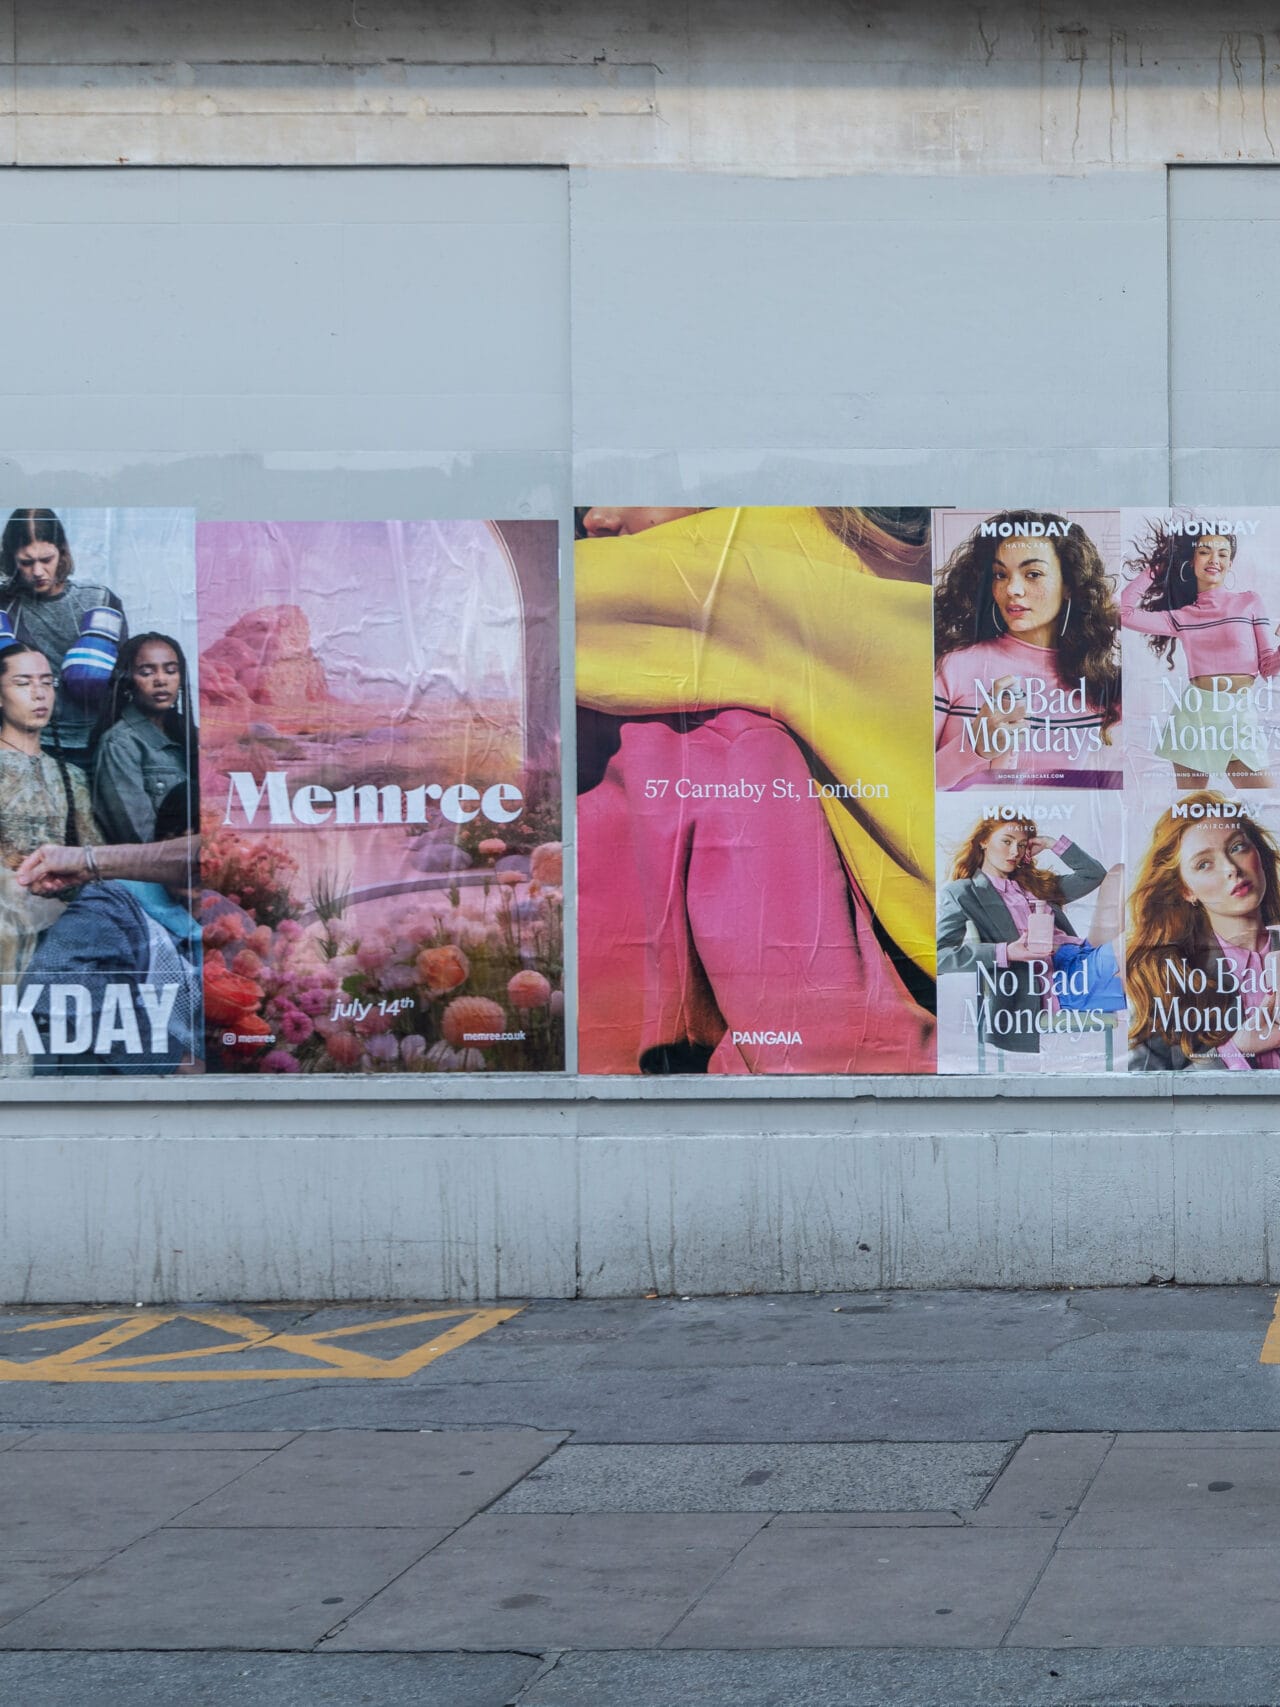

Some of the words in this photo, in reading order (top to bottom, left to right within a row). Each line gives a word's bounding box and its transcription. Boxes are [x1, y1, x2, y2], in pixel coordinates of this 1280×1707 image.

[980, 521, 1073, 537] MONDAY
[1167, 519, 1260, 536] MONDAY
[974, 677, 1016, 715] No
[1024, 676, 1087, 714] Bad
[1160, 676, 1203, 713] No
[1210, 675, 1273, 713] Bad
[959, 716, 1103, 761] Mondays
[222, 771, 524, 825] Memree
[643, 779, 670, 798] 57
[675, 778, 766, 803] Carnaby
[772, 778, 801, 801] St,
[807, 778, 889, 799] London
[982, 804, 1075, 821] MONDAY
[1171, 802, 1263, 819] MONDAY
[1197, 822, 1241, 830] HAIRCARE
[976, 960, 1018, 997] No
[1027, 959, 1089, 996] Bad
[1165, 957, 1207, 995] No
[1215, 956, 1278, 994] Bad
[0, 983, 180, 1055] KDAY
[331, 998, 372, 1022] july
[377, 997, 415, 1017] 14th
[962, 997, 1106, 1042] Mondays
[238, 1034, 276, 1044] memree
[463, 1030, 526, 1041] memree.co.uk
[732, 1031, 803, 1045] PANGAIA
